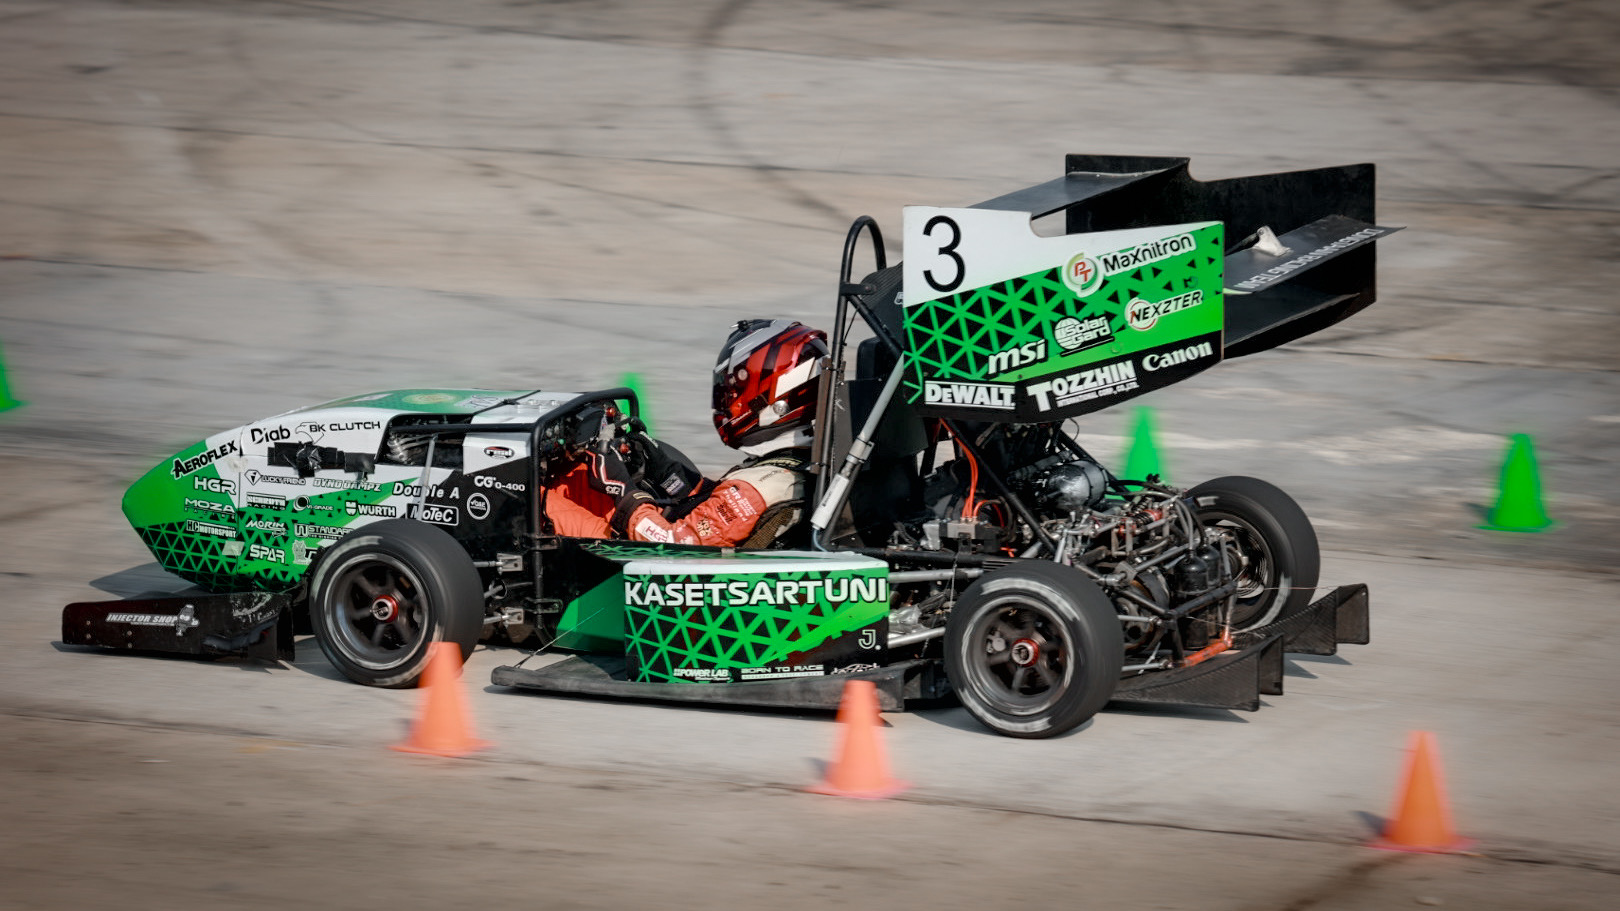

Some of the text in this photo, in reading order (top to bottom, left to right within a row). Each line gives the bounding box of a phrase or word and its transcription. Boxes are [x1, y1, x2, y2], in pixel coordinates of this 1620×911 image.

[922, 215, 966, 293] 3
[1130, 291, 1201, 324] NEXZTER
[988, 339, 1045, 375] msi
[1142, 342, 1213, 371] Canon
[1026, 360, 1137, 412] TOZZHIN
[250, 424, 290, 445] Diab
[309, 421, 380, 433] BK CLUTCH
[172, 440, 238, 479] AEROFLEX
[194, 476, 236, 495] HGR
[449, 487, 459, 499] A
[494, 483, 525, 492] 0-400
[185, 497, 235, 513] MOZA
[250, 544, 285, 563] SPAR
[106, 614, 151, 622] INJECTOR
[152, 615, 178, 623] SHOP
[711, 668, 729, 677] LAB
[741, 666, 771, 674] BORN
